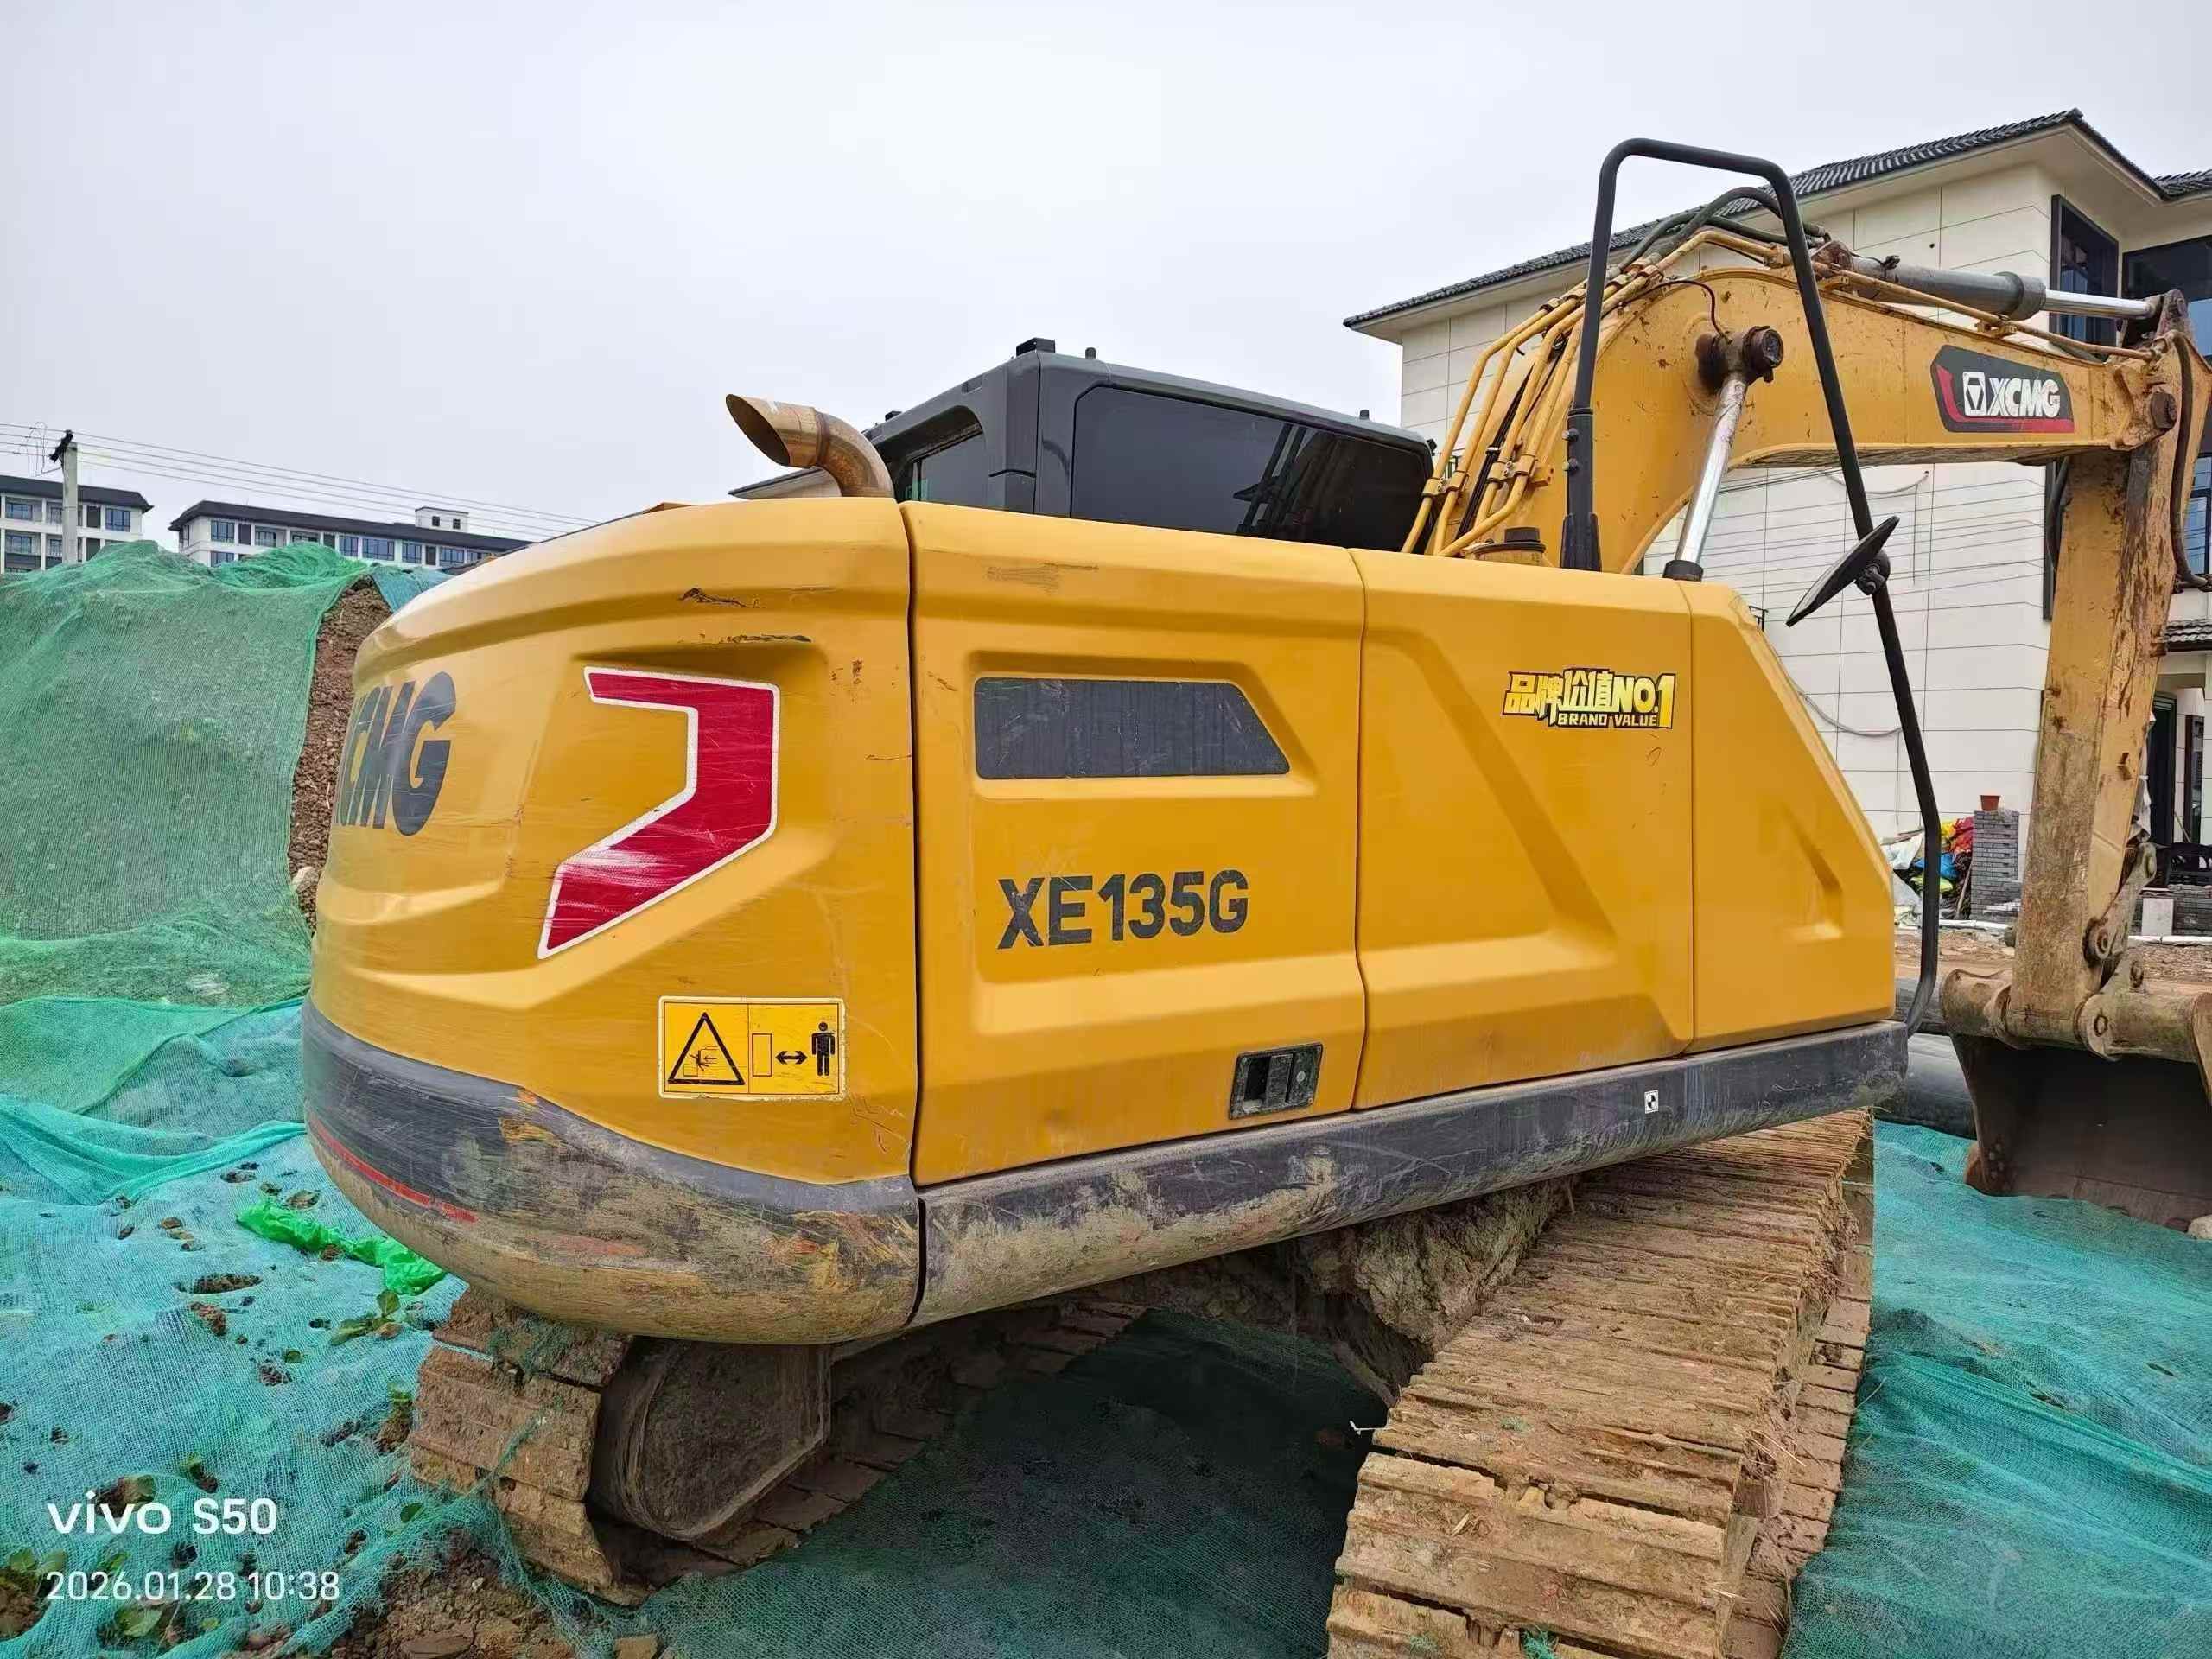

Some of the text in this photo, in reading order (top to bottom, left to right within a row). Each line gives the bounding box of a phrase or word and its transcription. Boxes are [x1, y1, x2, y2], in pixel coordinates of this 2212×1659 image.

[1987, 378, 2061, 418] XCMG
[1558, 713, 1657, 727] BRAND VALUE
[997, 869, 1249, 950] XE135G
